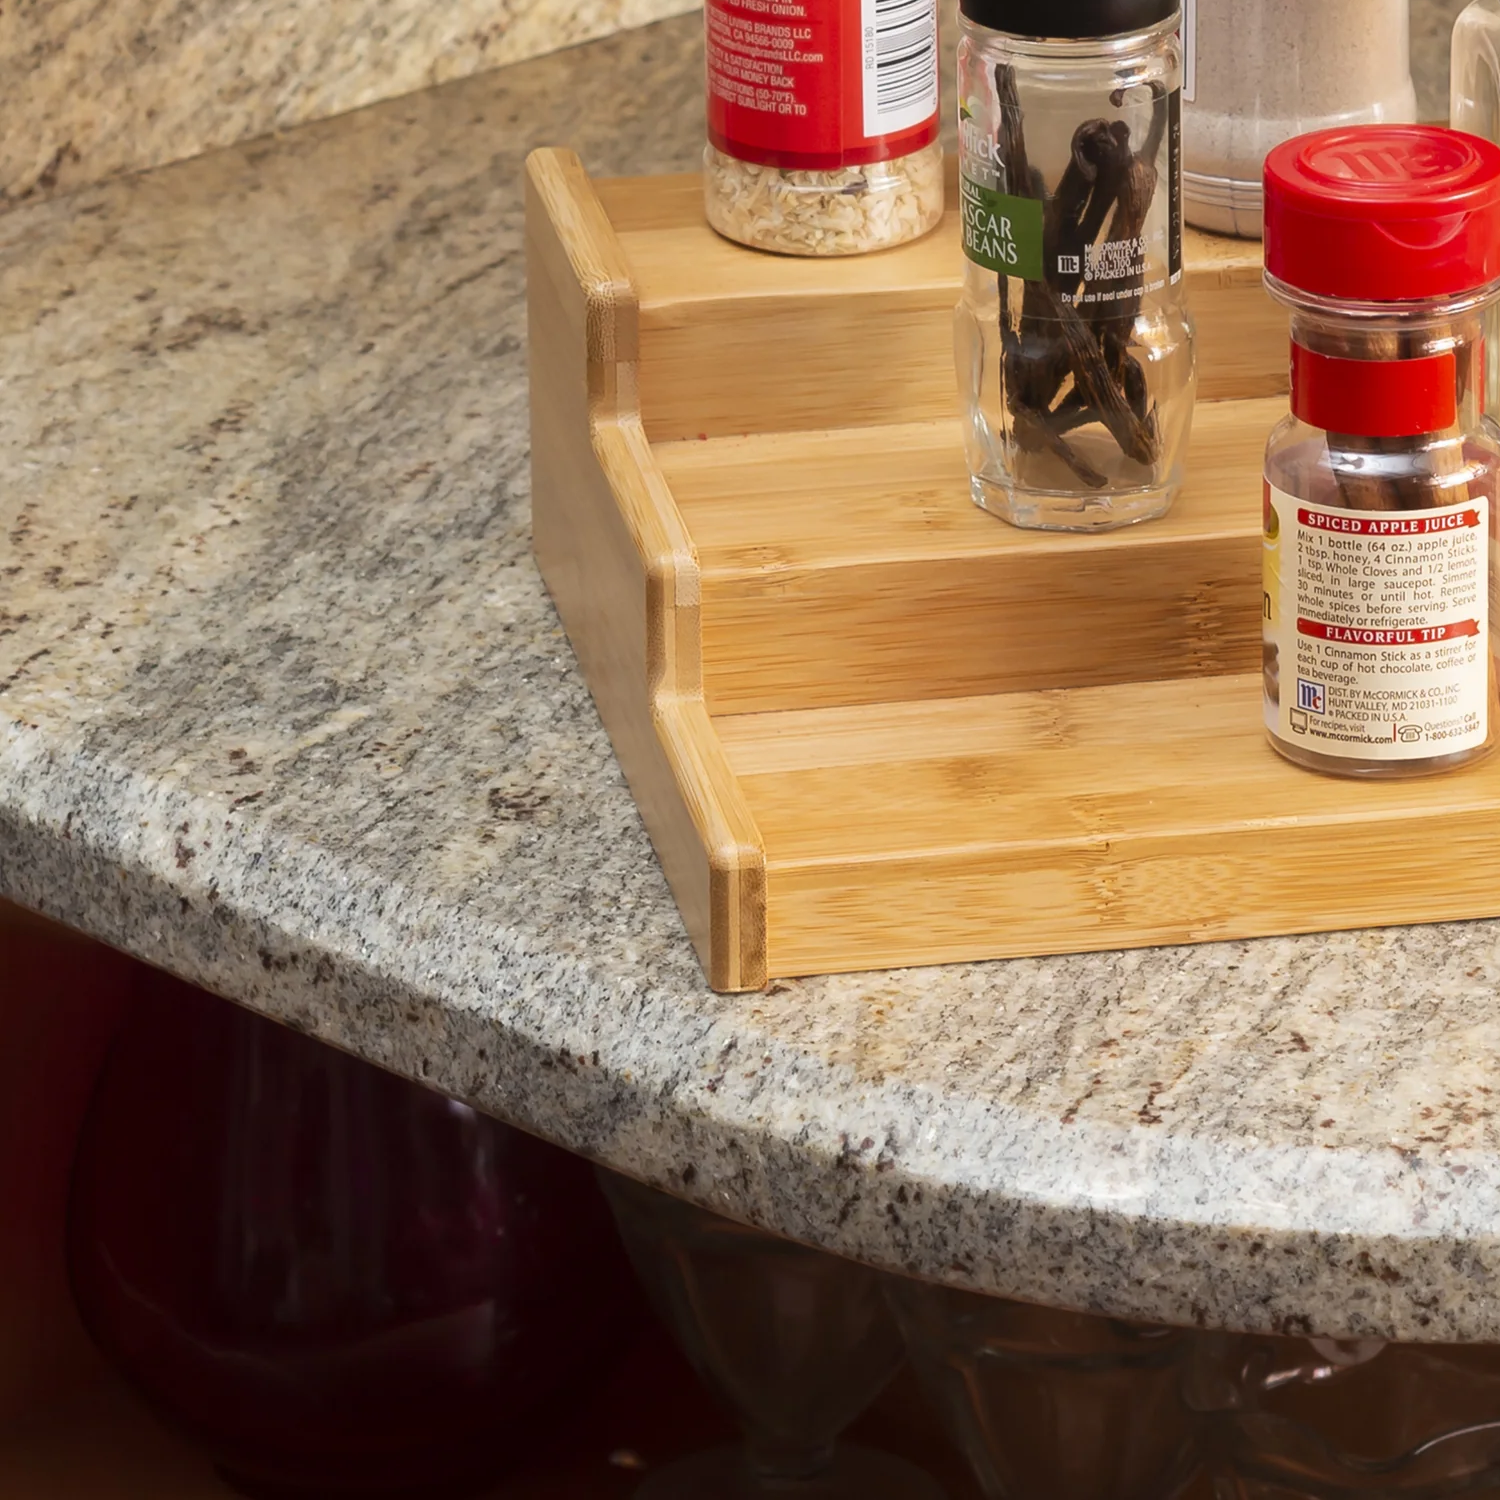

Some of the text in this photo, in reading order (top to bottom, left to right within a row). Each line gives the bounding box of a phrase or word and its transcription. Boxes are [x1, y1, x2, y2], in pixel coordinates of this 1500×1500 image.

[771, 3, 807, 17] ONION.
[754, 22, 811, 39] BRANDS LLC
[771, 76, 795, 88] BACK
[778, 104, 807, 116] OR TO
[966, 225, 1018, 265] BEANS
[1095, 266, 1134, 280] PACKED IN
[1061, 293, 1071, 302] Do
[1308, 513, 1464, 533] SPICED APPLE JUICE
[1297, 529, 1449, 553] Mix 1 bottle (64 oz.) apple
[1297, 542, 1444, 566] 2 tbsp. honey, 4 Cinnamon
[1298, 555, 1443, 577] 1 tsp. Whole Cloves and 1/2
[1331, 569, 1477, 591] in large saucepot. Simmer
[1297, 579, 1477, 601] 30 minutes or until hot. Remove
[1297, 593, 1477, 615] whole spices before serving. Serve
[1356, 617, 1369, 626] or
[1370, 616, 1428, 629] refrigerate.
[1326, 626, 1446, 643] FLAVORFUL TIP
[1297, 638, 1476, 661] Use 1 Cinnamon Stick as a stirrer for
[1297, 653, 1476, 674] each cup of hot chocolate, coffee or
[1297, 664, 1358, 685] tea beverage.
[1328, 686, 1426, 700] DIST. BY McCORMICK &
[1328, 695, 1458, 711] HUNT VALLEY, MD 21031-1100
[1309, 711, 1476, 733] For visit Call
[1335, 709, 1380, 721] PACKED IN
[1309, 728, 1393, 744] www.mccormick.com
